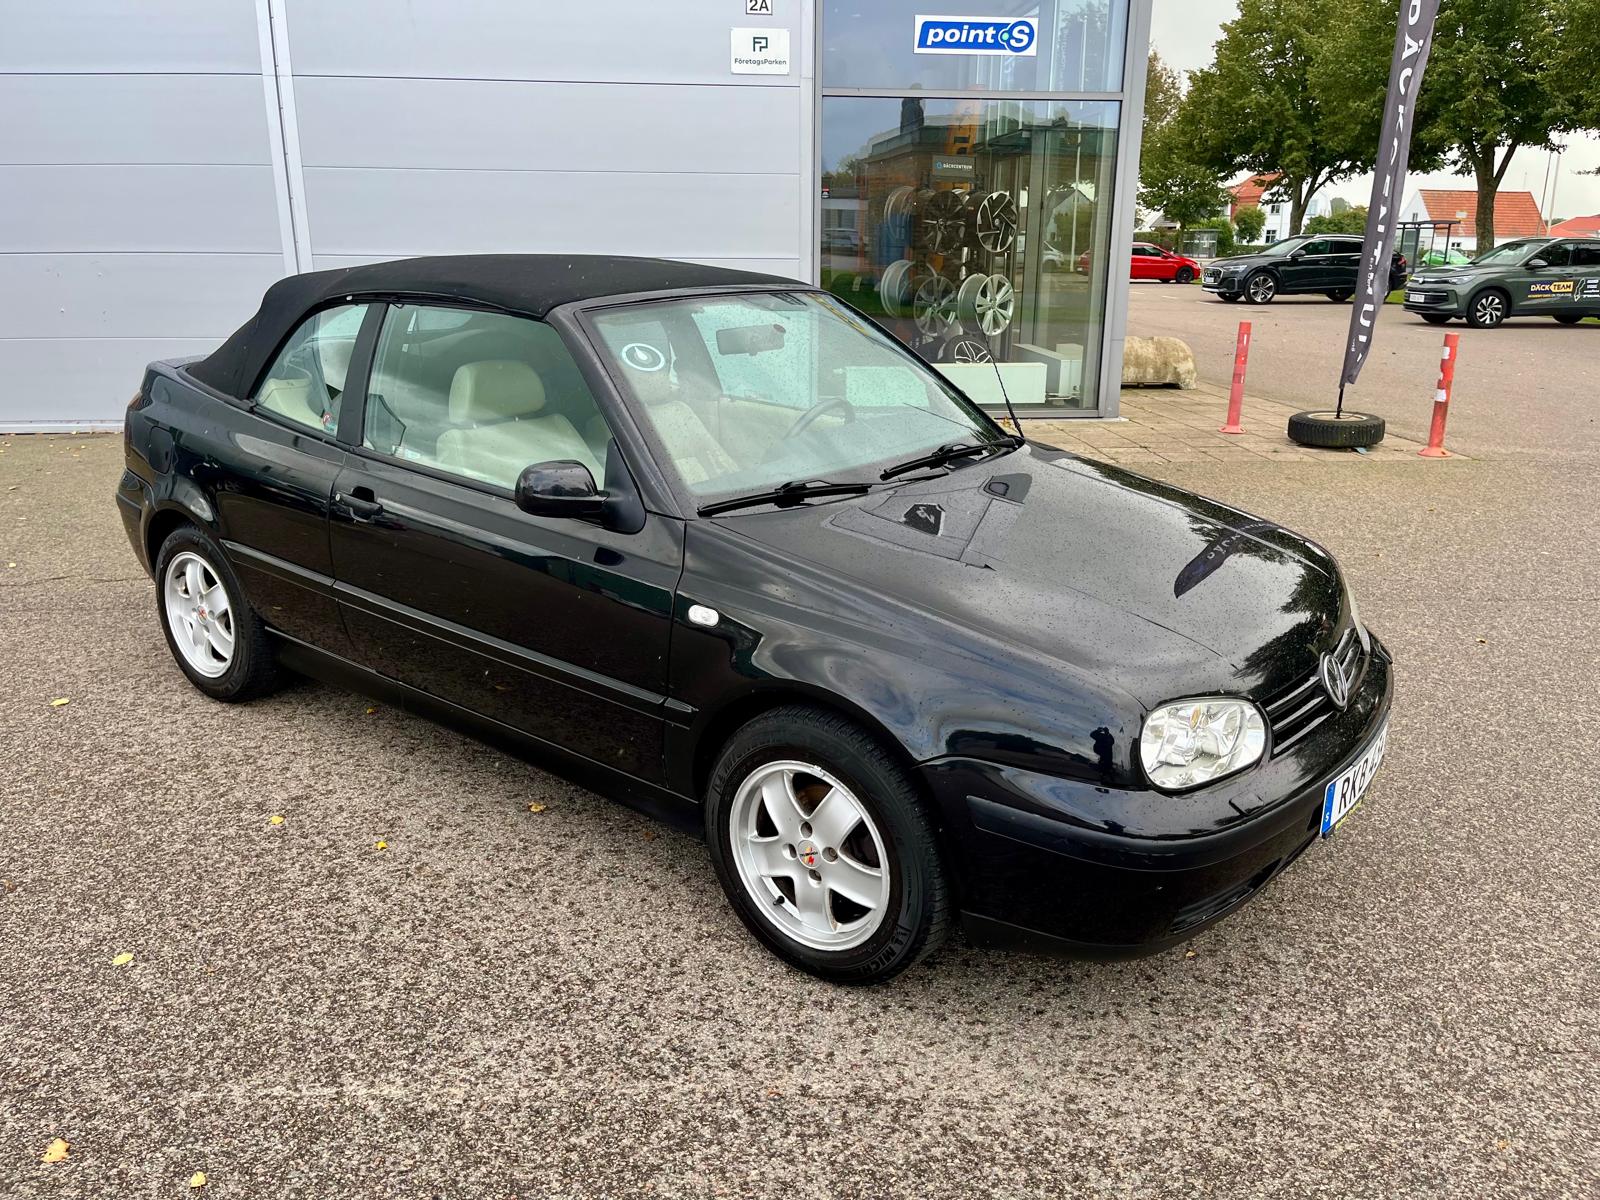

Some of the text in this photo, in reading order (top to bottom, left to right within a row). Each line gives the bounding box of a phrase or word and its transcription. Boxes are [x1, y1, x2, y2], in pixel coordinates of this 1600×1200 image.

[749, 0, 769, 12] 2A
[926, 24, 1030, 48] point S
[734, 57, 787, 66] FöretagsParken
[1530, 283, 1572, 292] DÄCK TEAM
[1338, 757, 1369, 815] RKB
